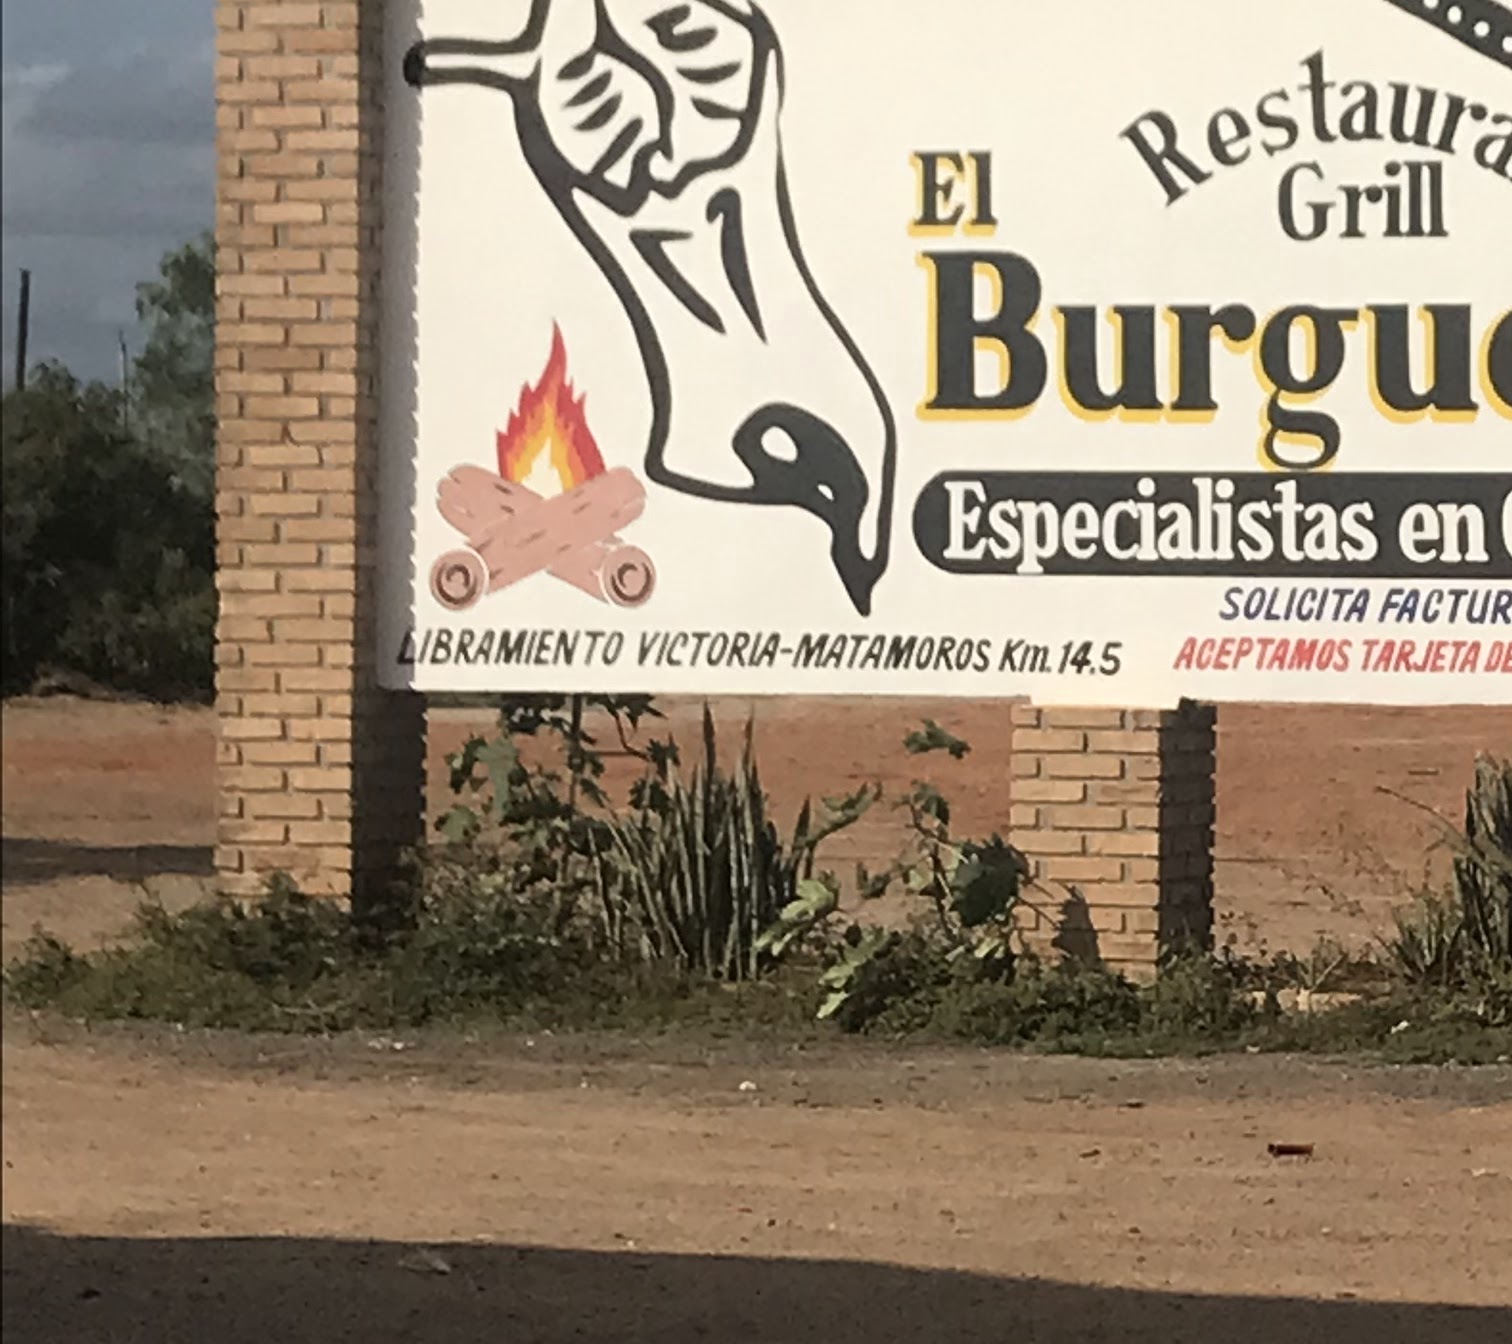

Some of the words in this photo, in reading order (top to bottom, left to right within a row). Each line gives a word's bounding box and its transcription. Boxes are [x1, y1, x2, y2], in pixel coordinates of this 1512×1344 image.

[907, 150, 997, 236] El
[1277, 160, 1448, 242] Grill
[942, 477, 1378, 572] Especialistas
[1398, 502, 1489, 563] en
[1220, 587, 1369, 624] SOLICITA
[397, 628, 624, 666] LIBRAMIENTO
[638, 631, 991, 672] VICTORIA-MATAMOROS
[1173, 637, 1351, 672] ACEPTAMOS
[1360, 638, 1479, 674] TARJETA
